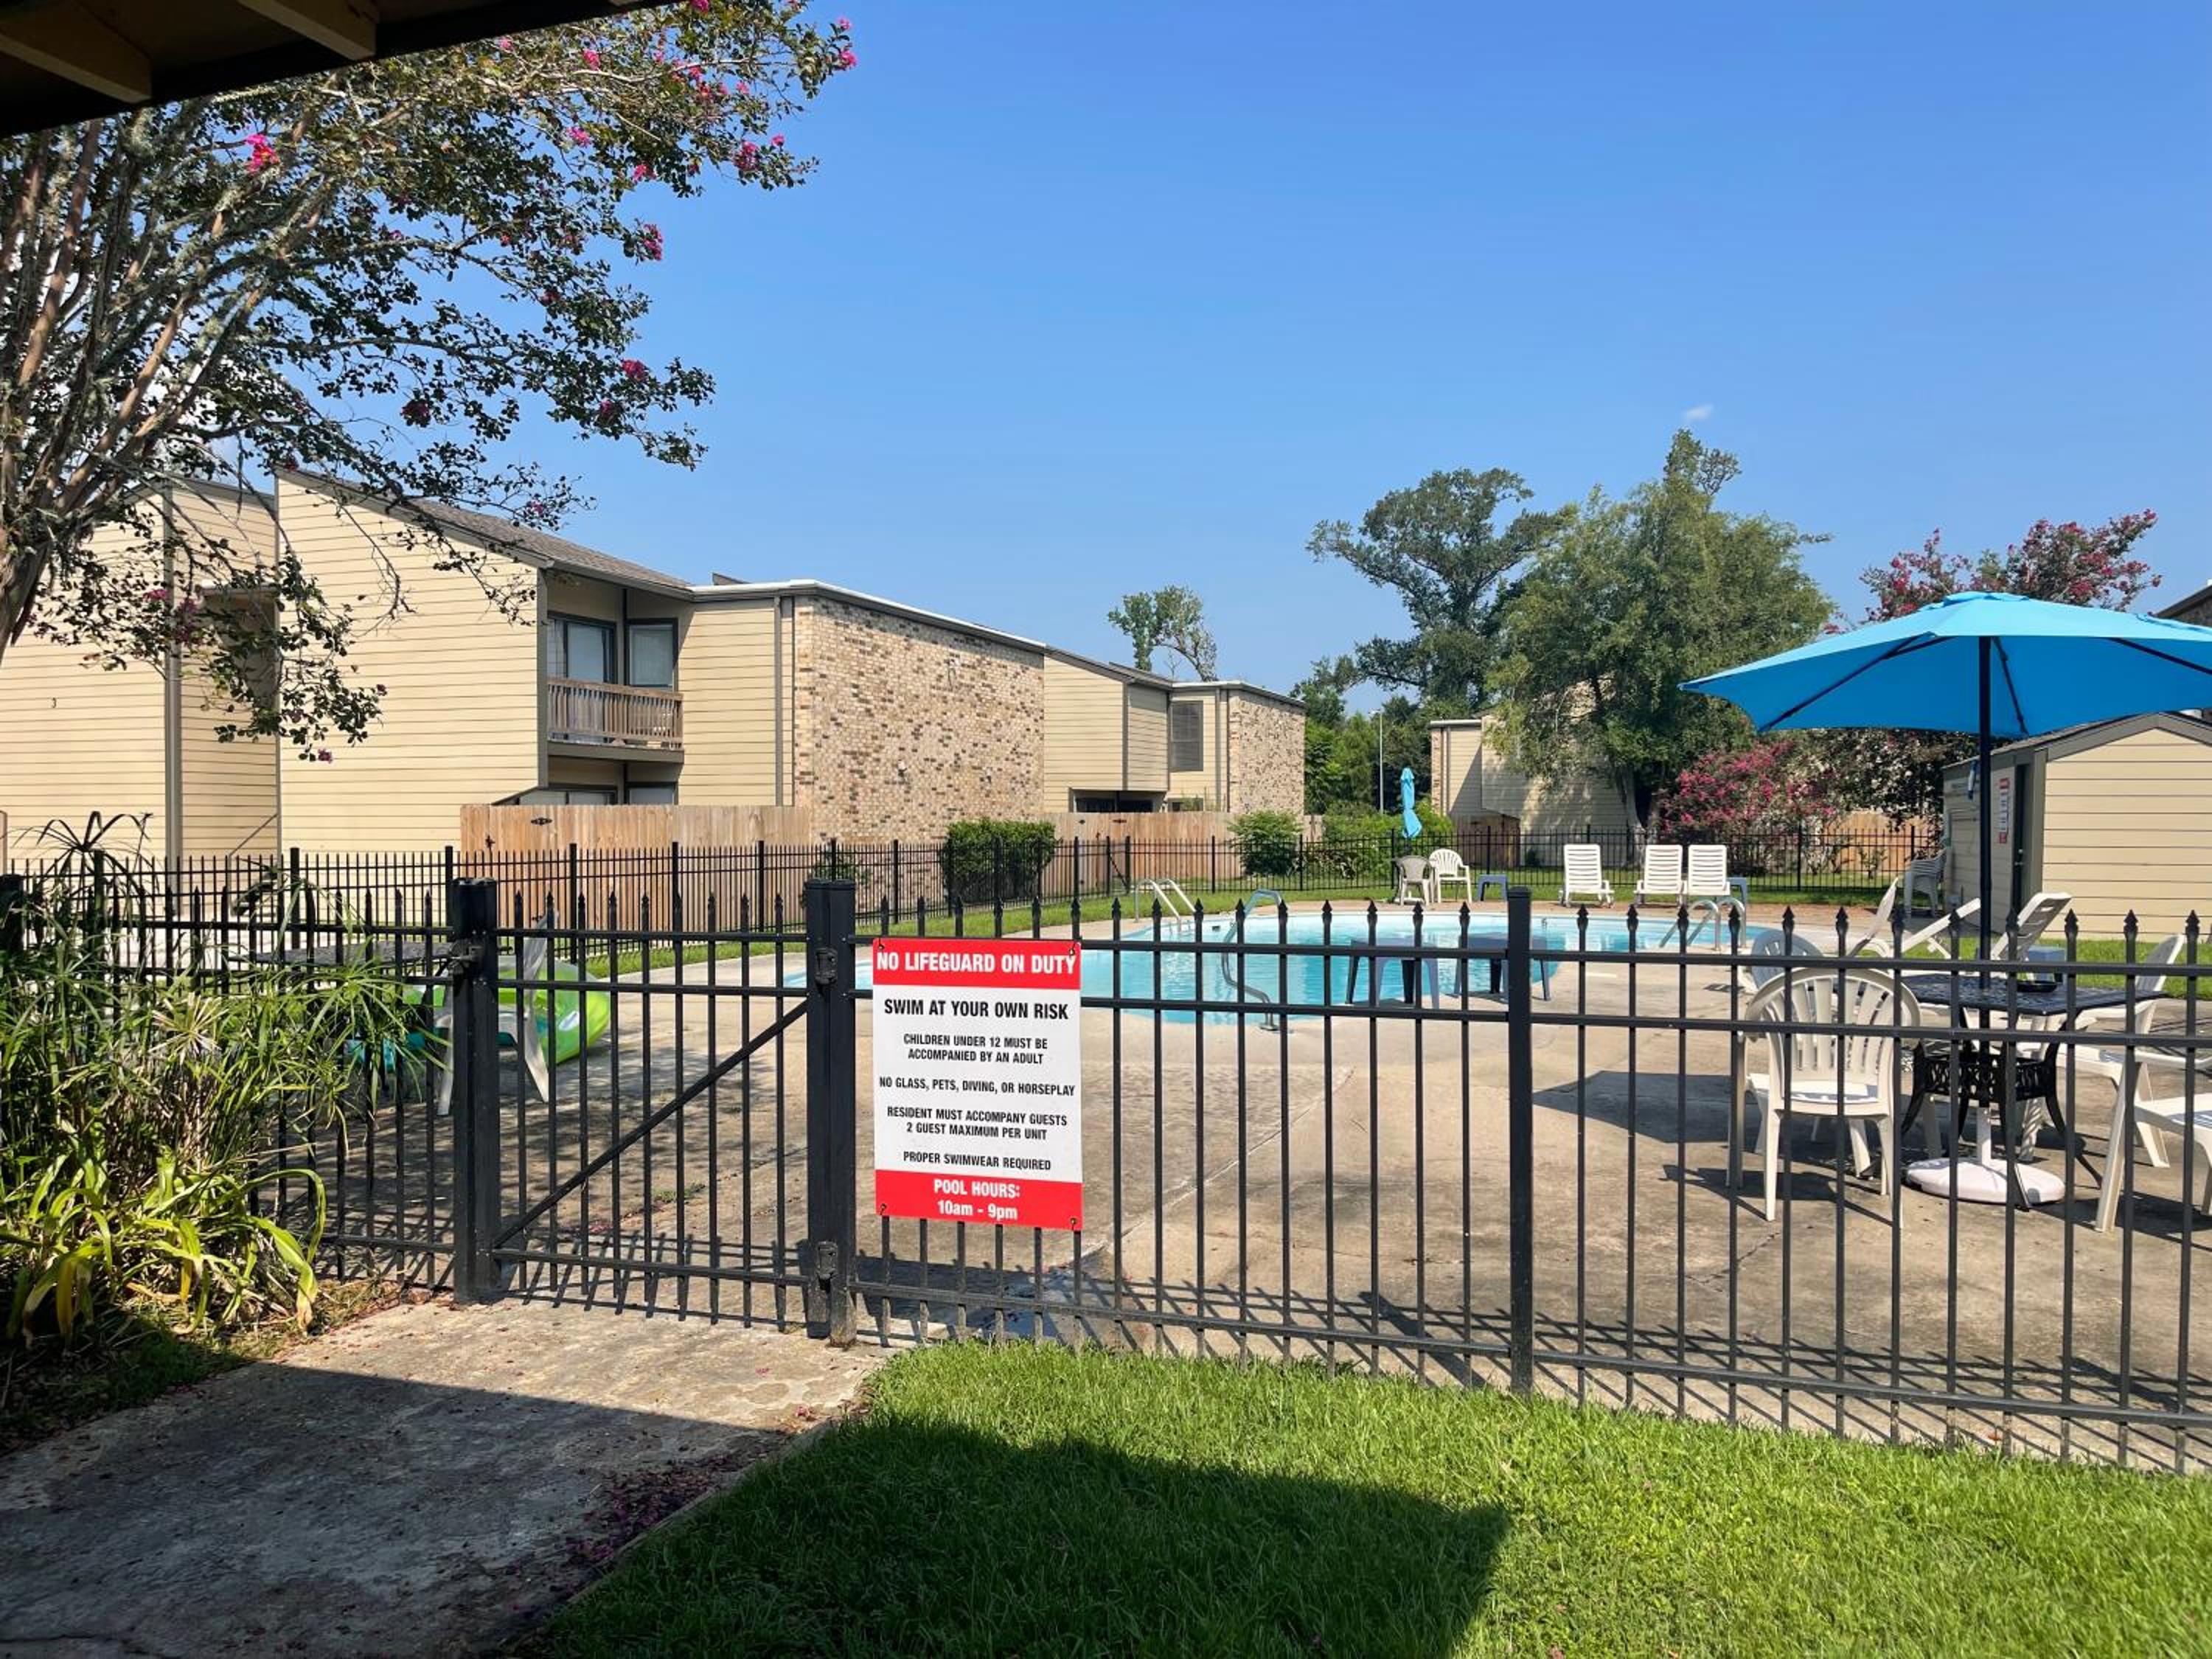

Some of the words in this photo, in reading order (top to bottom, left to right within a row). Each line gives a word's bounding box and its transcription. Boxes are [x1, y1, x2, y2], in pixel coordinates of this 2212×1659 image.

[877, 952, 899, 970] NO
[905, 953, 995, 973] LIFEGUARD
[1002, 954, 1024, 973] ON
[1032, 955, 1077, 974] DUTY
[884, 998, 923, 1015] SWIM
[929, 1000, 945, 1015] AT
[952, 1001, 989, 1017] YOUR
[995, 1002, 1028, 1018] OWN
[1034, 1004, 1068, 1020] RISK
[903, 1034, 950, 1046] CHILDREN
[953, 1036, 986, 1047] UNDER
[990, 1037, 1000, 1047] 12
[1004, 1037, 1032, 1048] MUST
[1035, 1038, 1048, 1049] BE
[908, 1048, 976, 1061] ACCOMPANIED
[980, 1051, 992, 1062] BY
[995, 1052, 1009, 1062] AN
[1013, 1053, 1043, 1064] ADULT
[880, 1077, 892, 1088] NO
[896, 1077, 930, 1091] GLASS,
[933, 1079, 959, 1092] PETS,
[962, 1080, 998, 1093] DIVING,
[1001, 1082, 1014, 1093] OR
[1018, 1083, 1075, 1096] HORSEPLAY
[887, 1106, 932, 1119] RESIDENT
[936, 1109, 962, 1120] MUST
[966, 1110, 1026, 1124] ACCOMPANY
[1029, 1113, 1067, 1126] GUESTS
[907, 1122, 912, 1133] 2
[917, 1122, 945, 1134] GUEST
[949, 1124, 999, 1137] MAXIMUM
[1003, 1127, 1020, 1138] PER
[1025, 1128, 1047, 1140] UNIT
[903, 1151, 940, 1164] PROPER
[945, 1154, 999, 1167] SWIMWEAR
[1003, 1157, 1051, 1170] REQUIRED
[934, 1179, 967, 1194] POOL
[972, 1180, 1020, 1198] HOURS:
[937, 1200, 973, 1215] 10am
[988, 1203, 1018, 1220] 9pm
